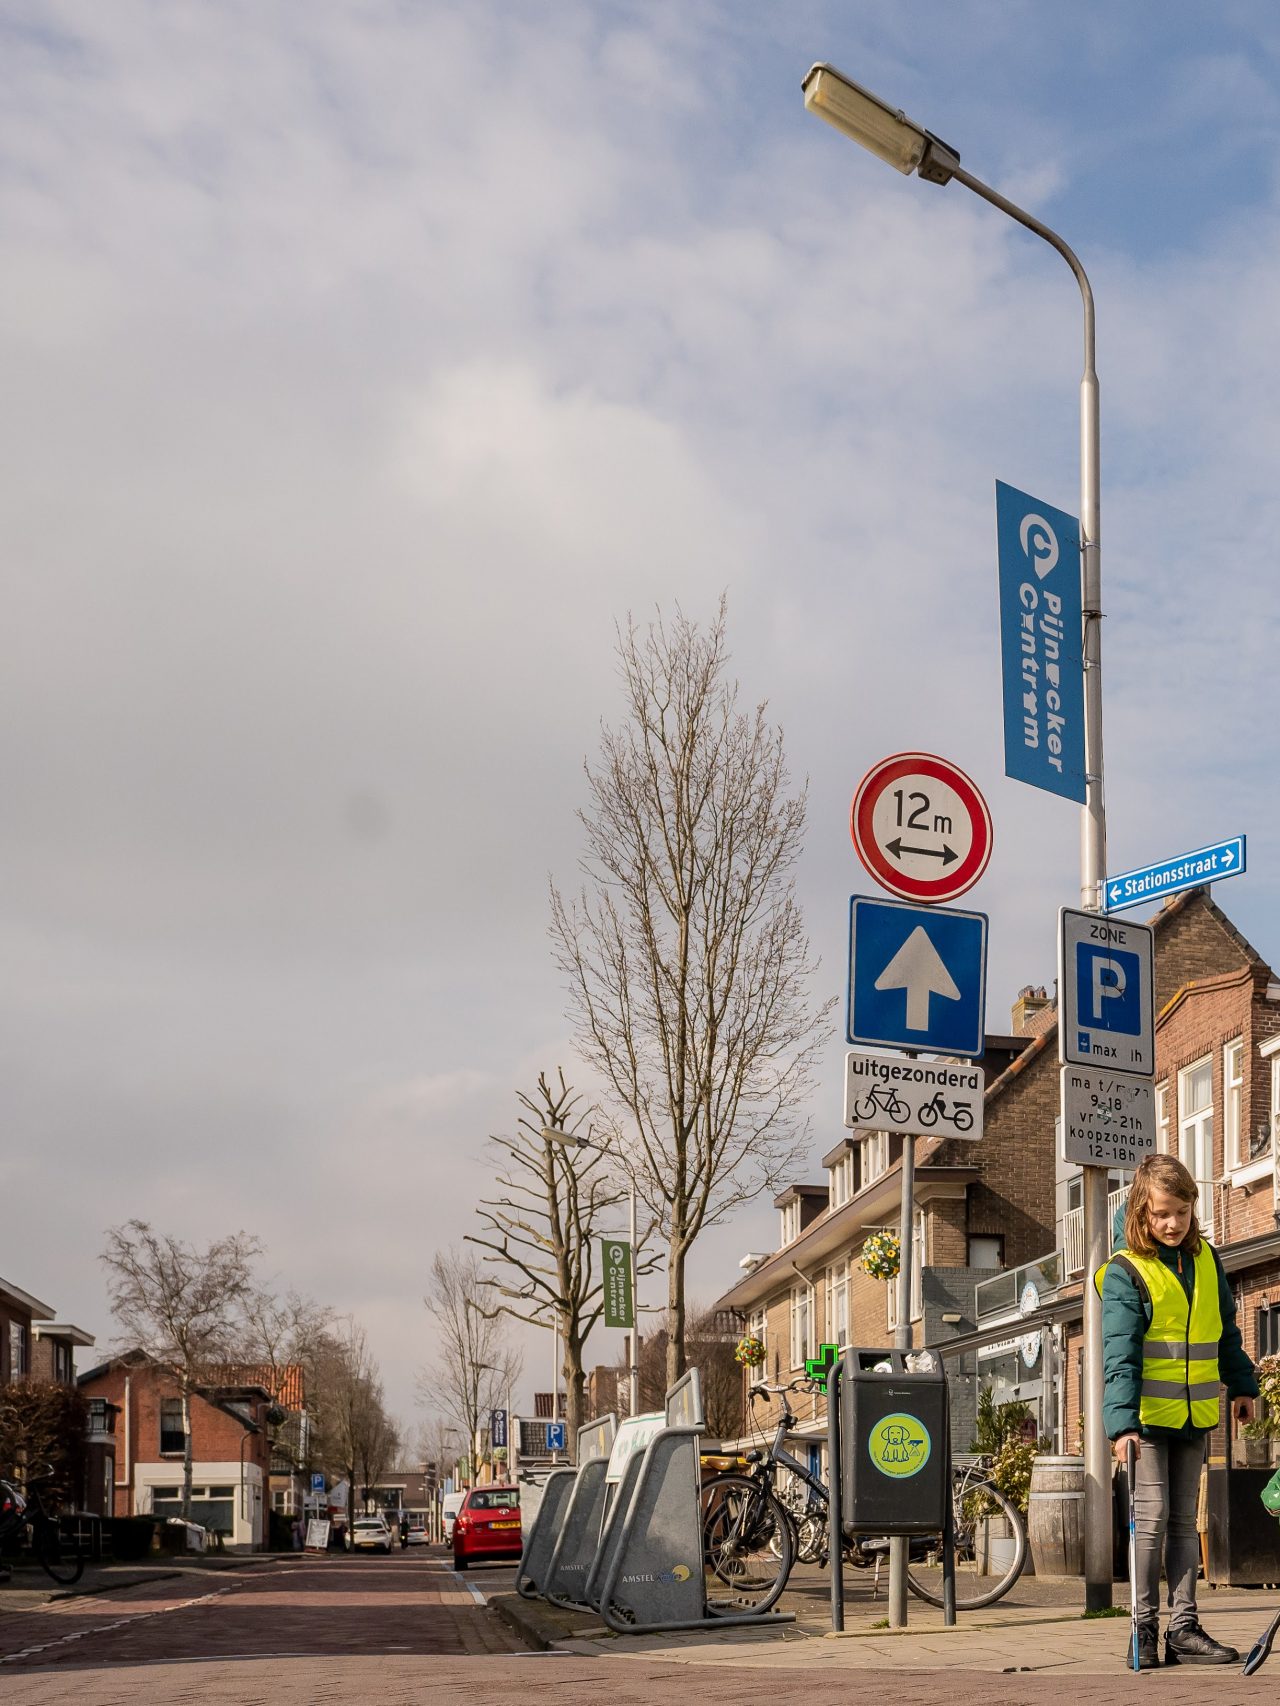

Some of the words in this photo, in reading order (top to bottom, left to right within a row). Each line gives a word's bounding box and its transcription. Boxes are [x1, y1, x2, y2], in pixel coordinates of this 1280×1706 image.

[1019, 582, 1040, 750] Cntrm
[1040, 590, 1066, 773] Pijncker
[1124, 853, 1217, 896] Stationsstraat
[1090, 924, 1126, 944] ZONE
[1092, 955, 1126, 1019] P
[1093, 1044, 1117, 1058] max
[852, 1058, 978, 1089] uitgezonderd
[1071, 1077, 1091, 1089] ma
[1080, 1112, 1093, 1123] vr
[1088, 1144, 1136, 1161] 12-18h
[609, 1267, 617, 1317] Cntrm
[616, 1267, 626, 1321] Pijncker
[622, 1575, 655, 1583] AMSTEL
